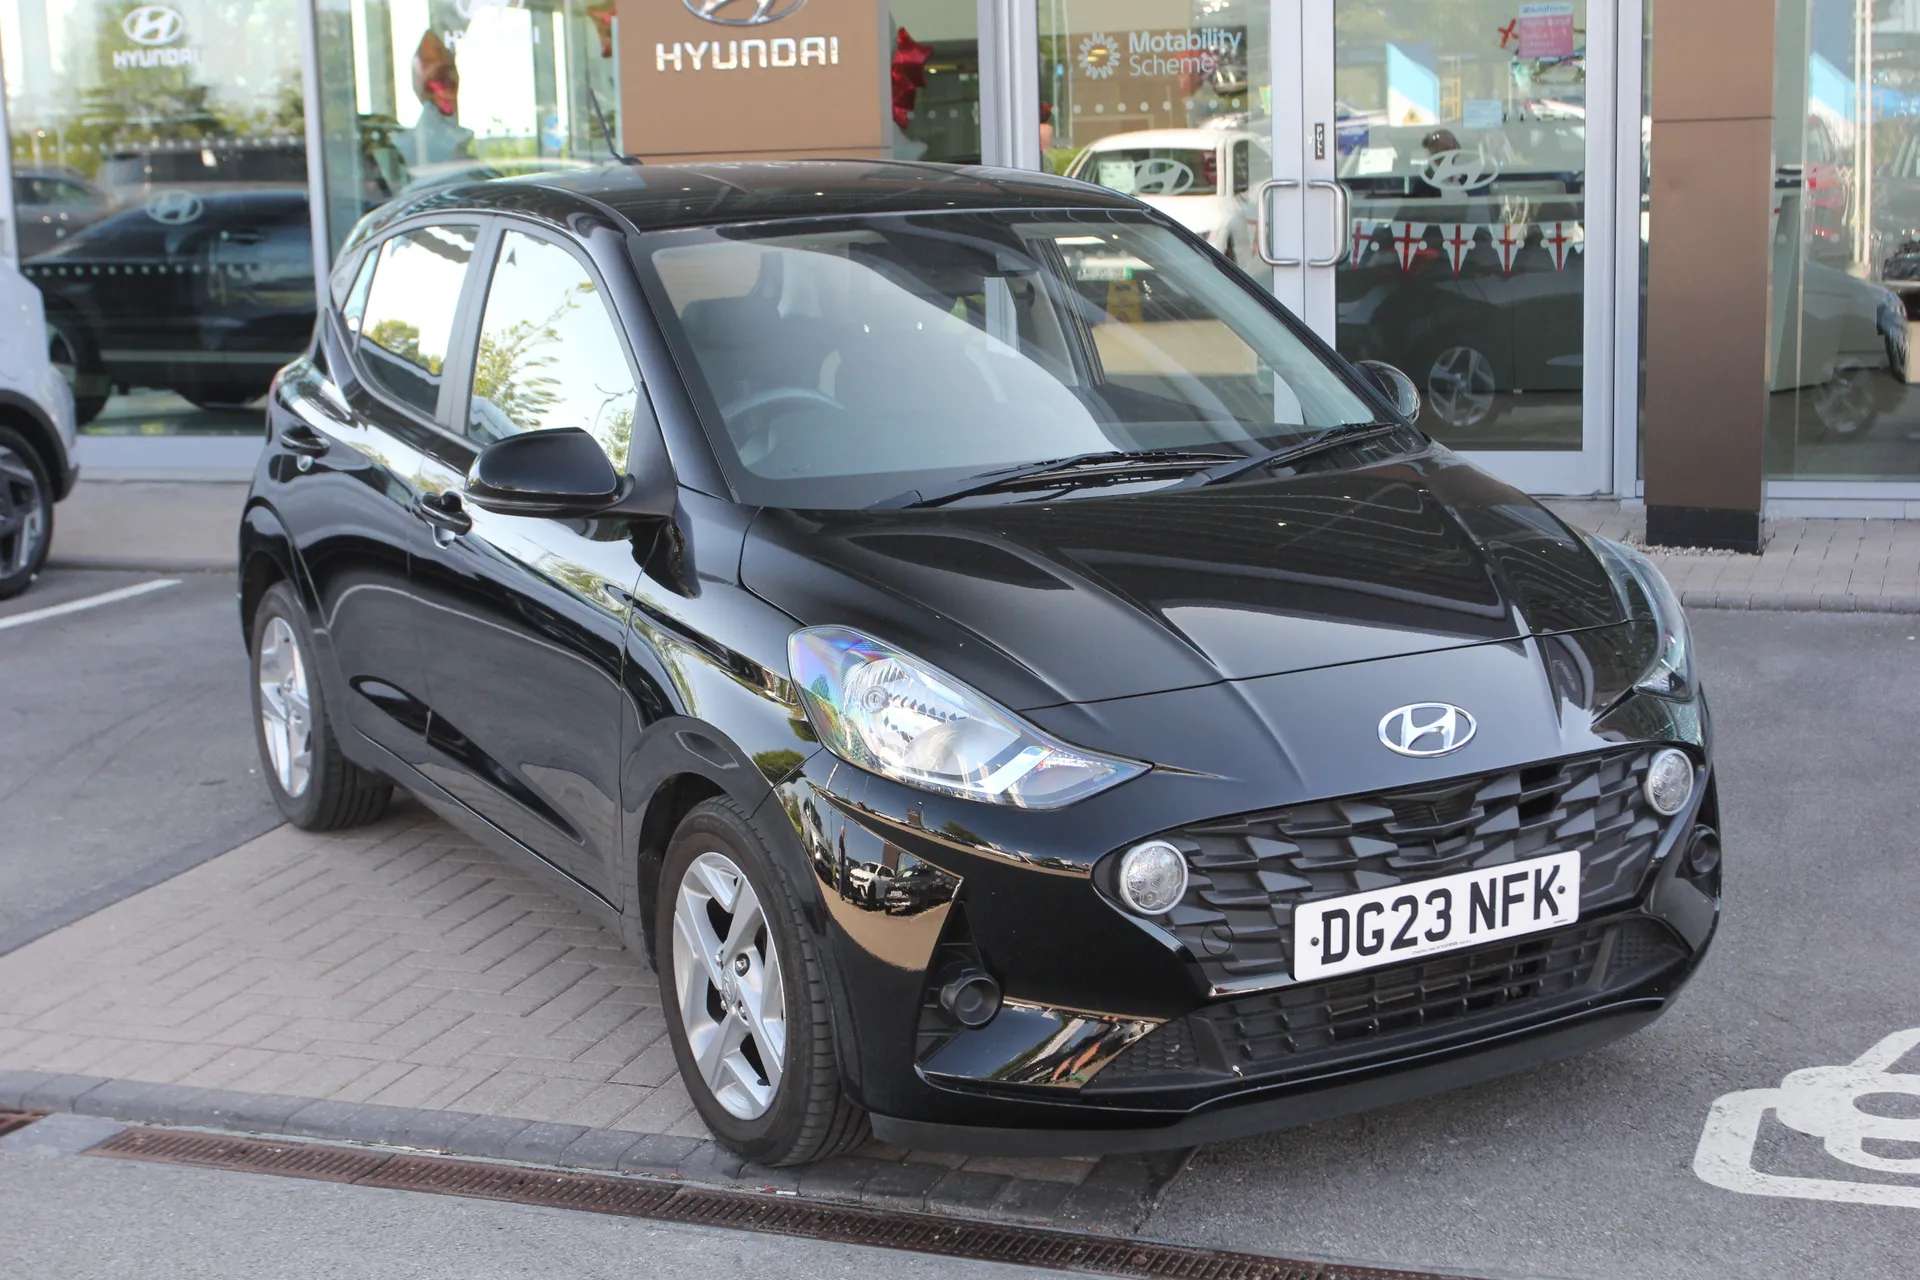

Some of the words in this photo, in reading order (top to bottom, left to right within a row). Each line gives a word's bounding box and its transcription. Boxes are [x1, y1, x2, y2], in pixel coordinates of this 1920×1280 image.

[655, 36, 840, 72] HYUNDAI
[1128, 28, 1242, 55] Motability
[1129, 54, 1215, 76] Scheme
[1321, 888, 1453, 965] DG23
[1469, 864, 1561, 934] NFK
